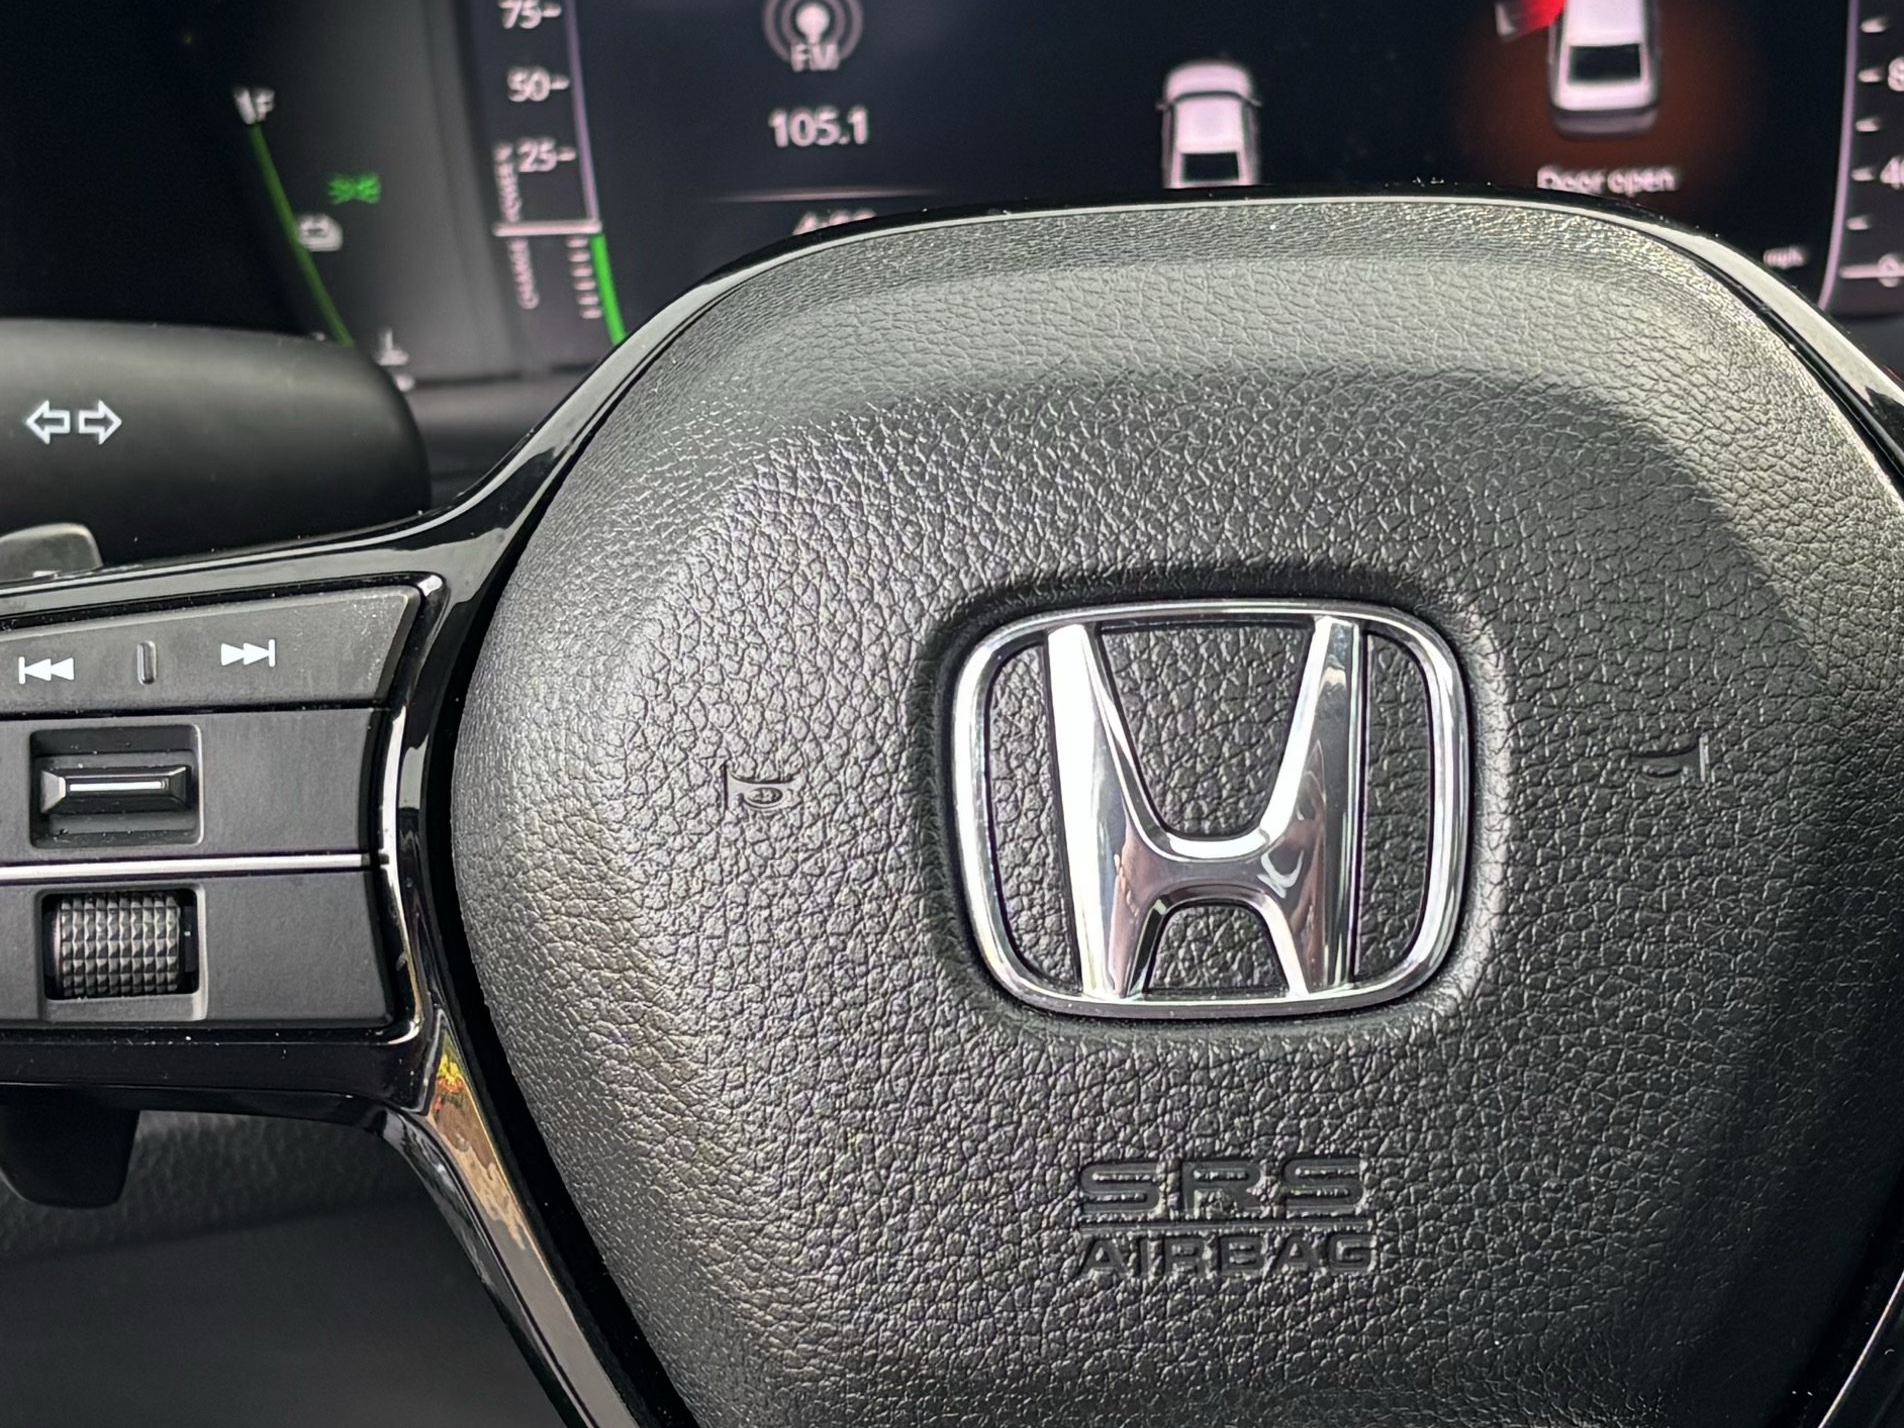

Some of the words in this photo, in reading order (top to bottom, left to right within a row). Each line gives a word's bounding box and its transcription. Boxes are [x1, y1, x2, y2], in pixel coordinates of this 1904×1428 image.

[508, 65, 553, 103] 50
[768, 104, 869, 147] 105.1
[517, 137, 560, 172] 25
[1536, 166, 1606, 194] Door
[1607, 167, 1679, 197] open
[1078, 1156, 1366, 1217] SRS
[1075, 1232, 1378, 1278] AIRBAG
